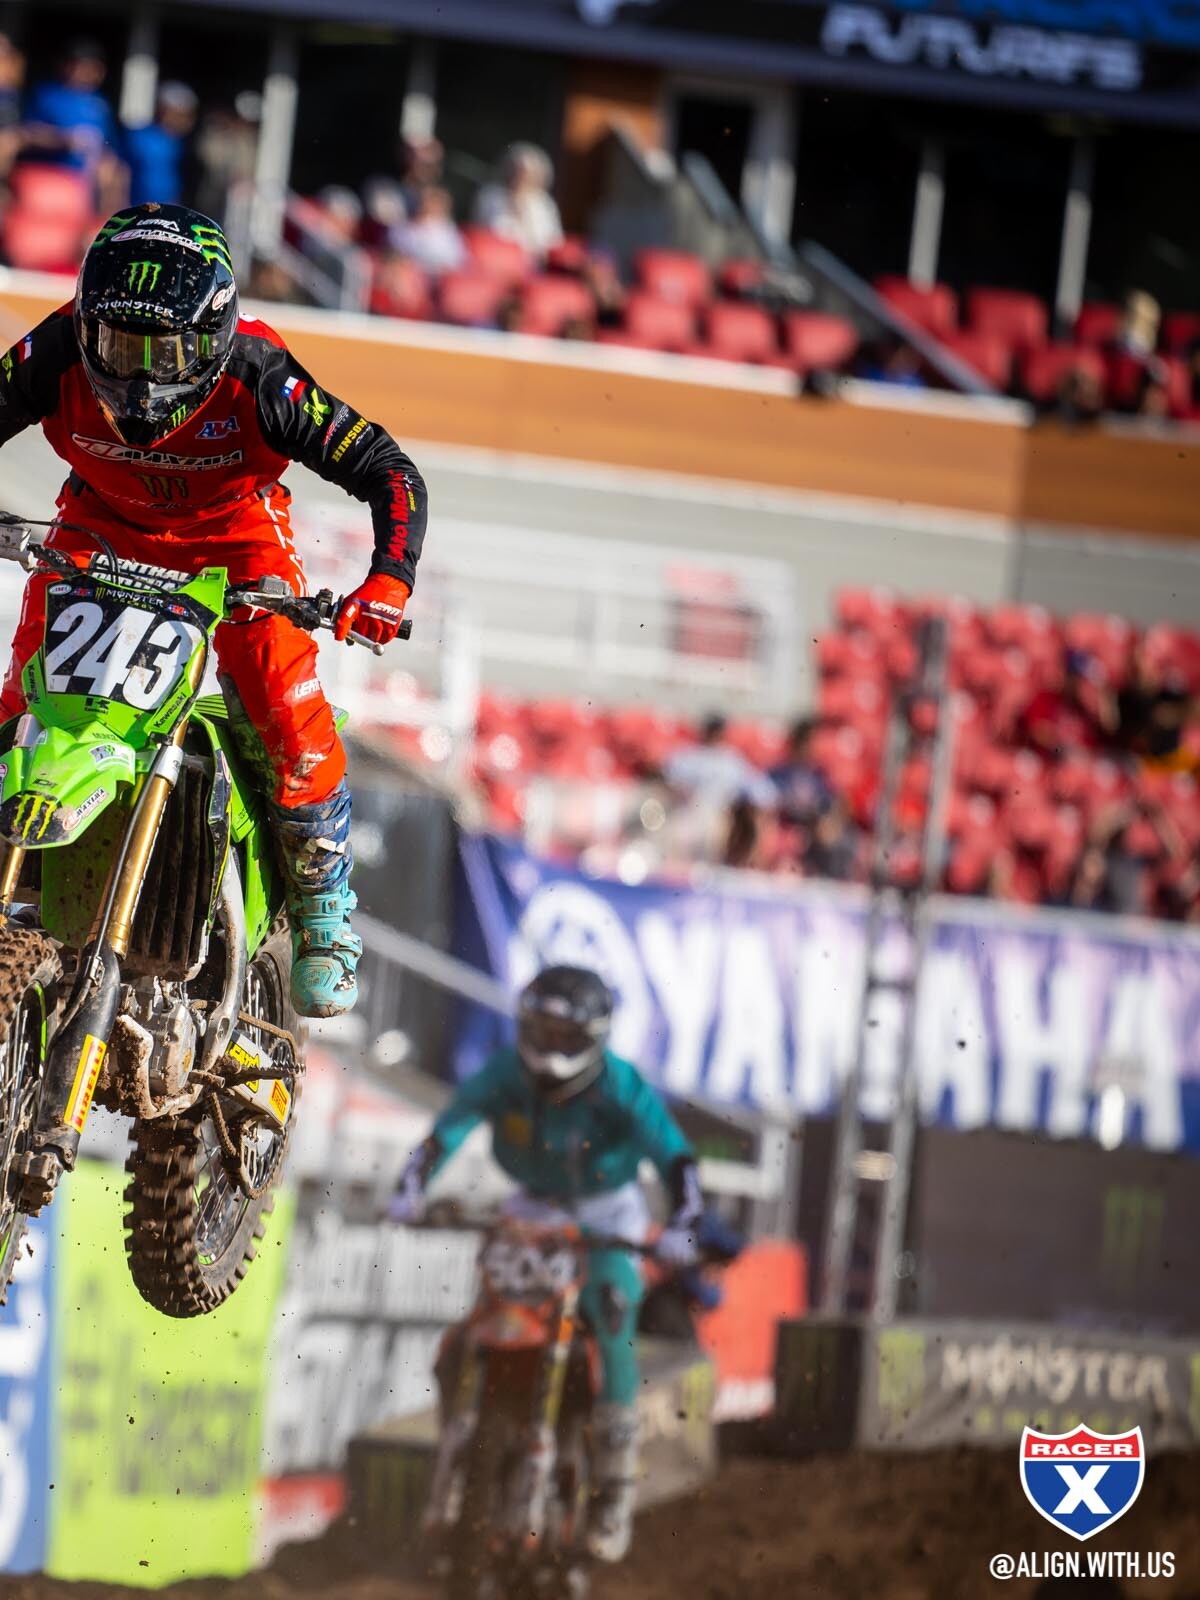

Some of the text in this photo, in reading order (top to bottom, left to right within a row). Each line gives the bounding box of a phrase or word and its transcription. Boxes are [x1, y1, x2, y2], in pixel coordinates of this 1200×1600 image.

[96, 299, 174, 318] MONSTER
[332, 418, 368, 463] HINSON
[106, 588, 164, 607] MONSTER
[369, 600, 403, 616] LEATT
[45, 601, 203, 711] 243
[153, 692, 187, 728] Kawasaki
[635, 908, 1186, 1152] YAMAHA
